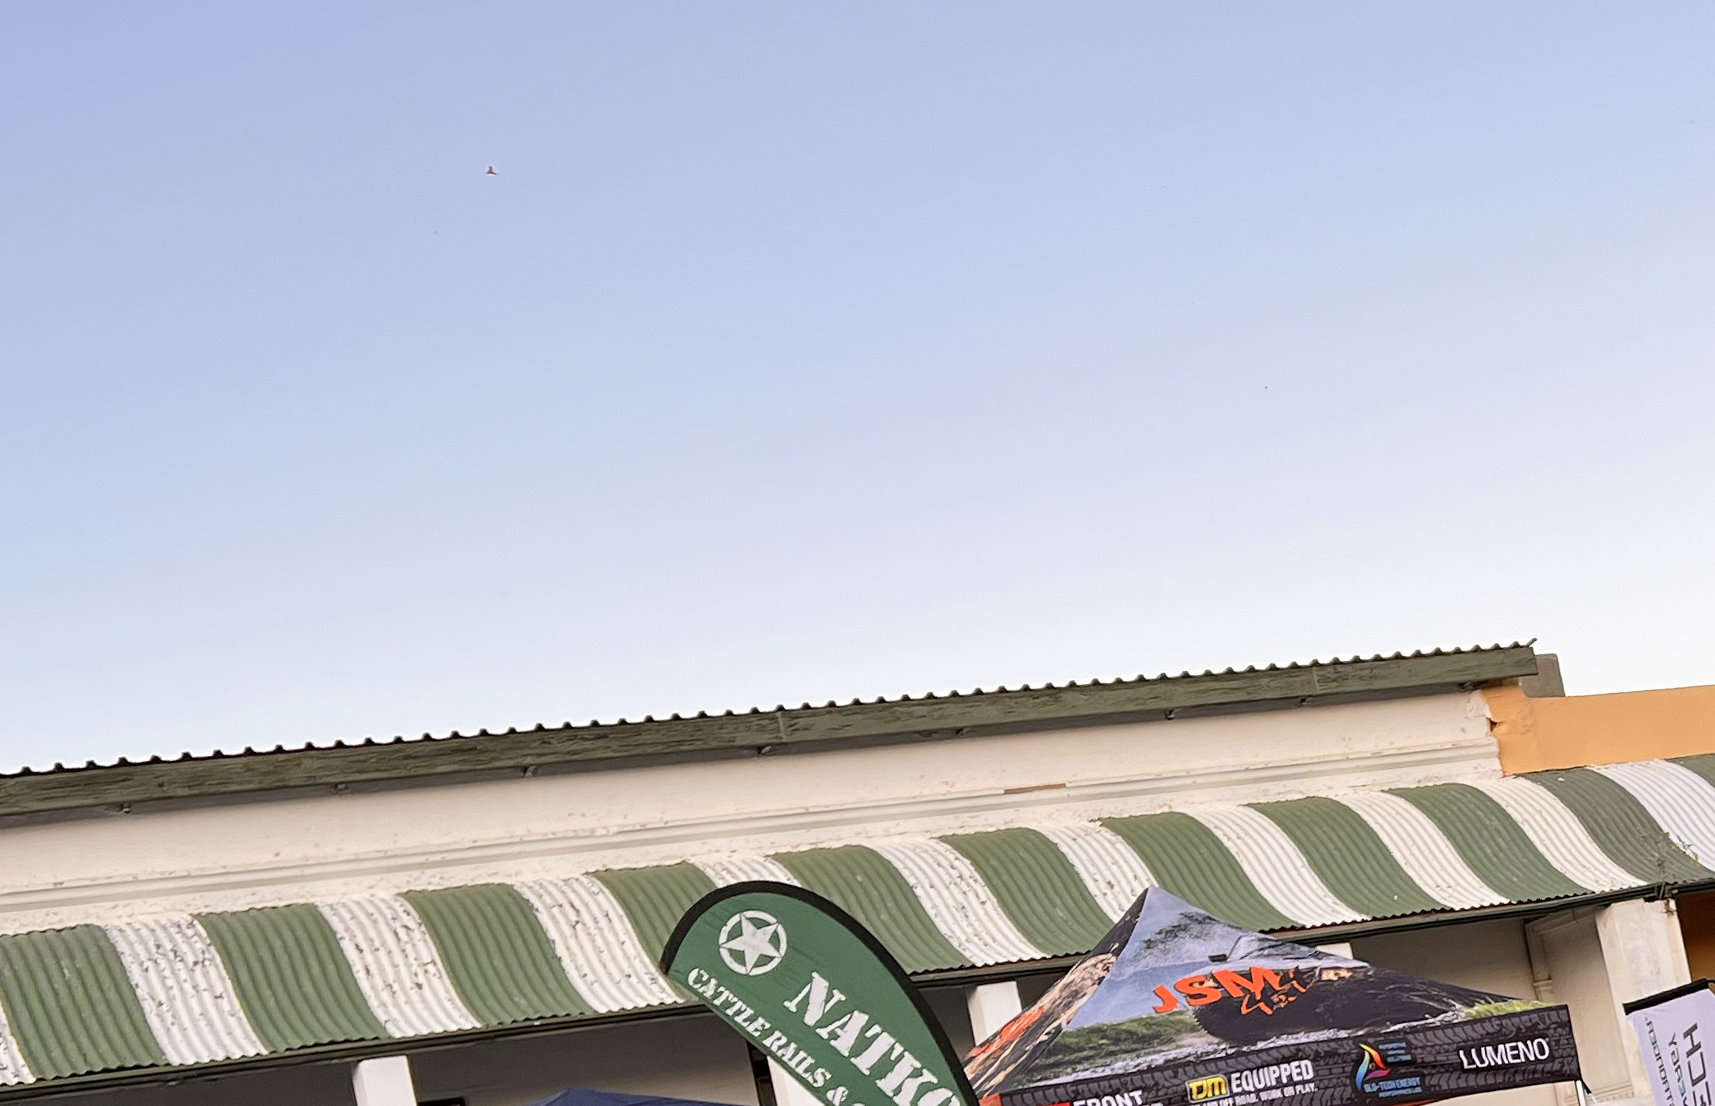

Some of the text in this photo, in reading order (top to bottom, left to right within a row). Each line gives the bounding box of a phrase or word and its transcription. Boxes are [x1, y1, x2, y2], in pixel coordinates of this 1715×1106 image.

[1153, 966, 1283, 1014] JSM
[688, 968, 771, 1038] CATTLE
[763, 1030, 832, 1087] RAILS
[826, 1086, 848, 1106] &
[1459, 1038, 1550, 1070] LUMENO
[1230, 1059, 1315, 1094] EQUIPPED
